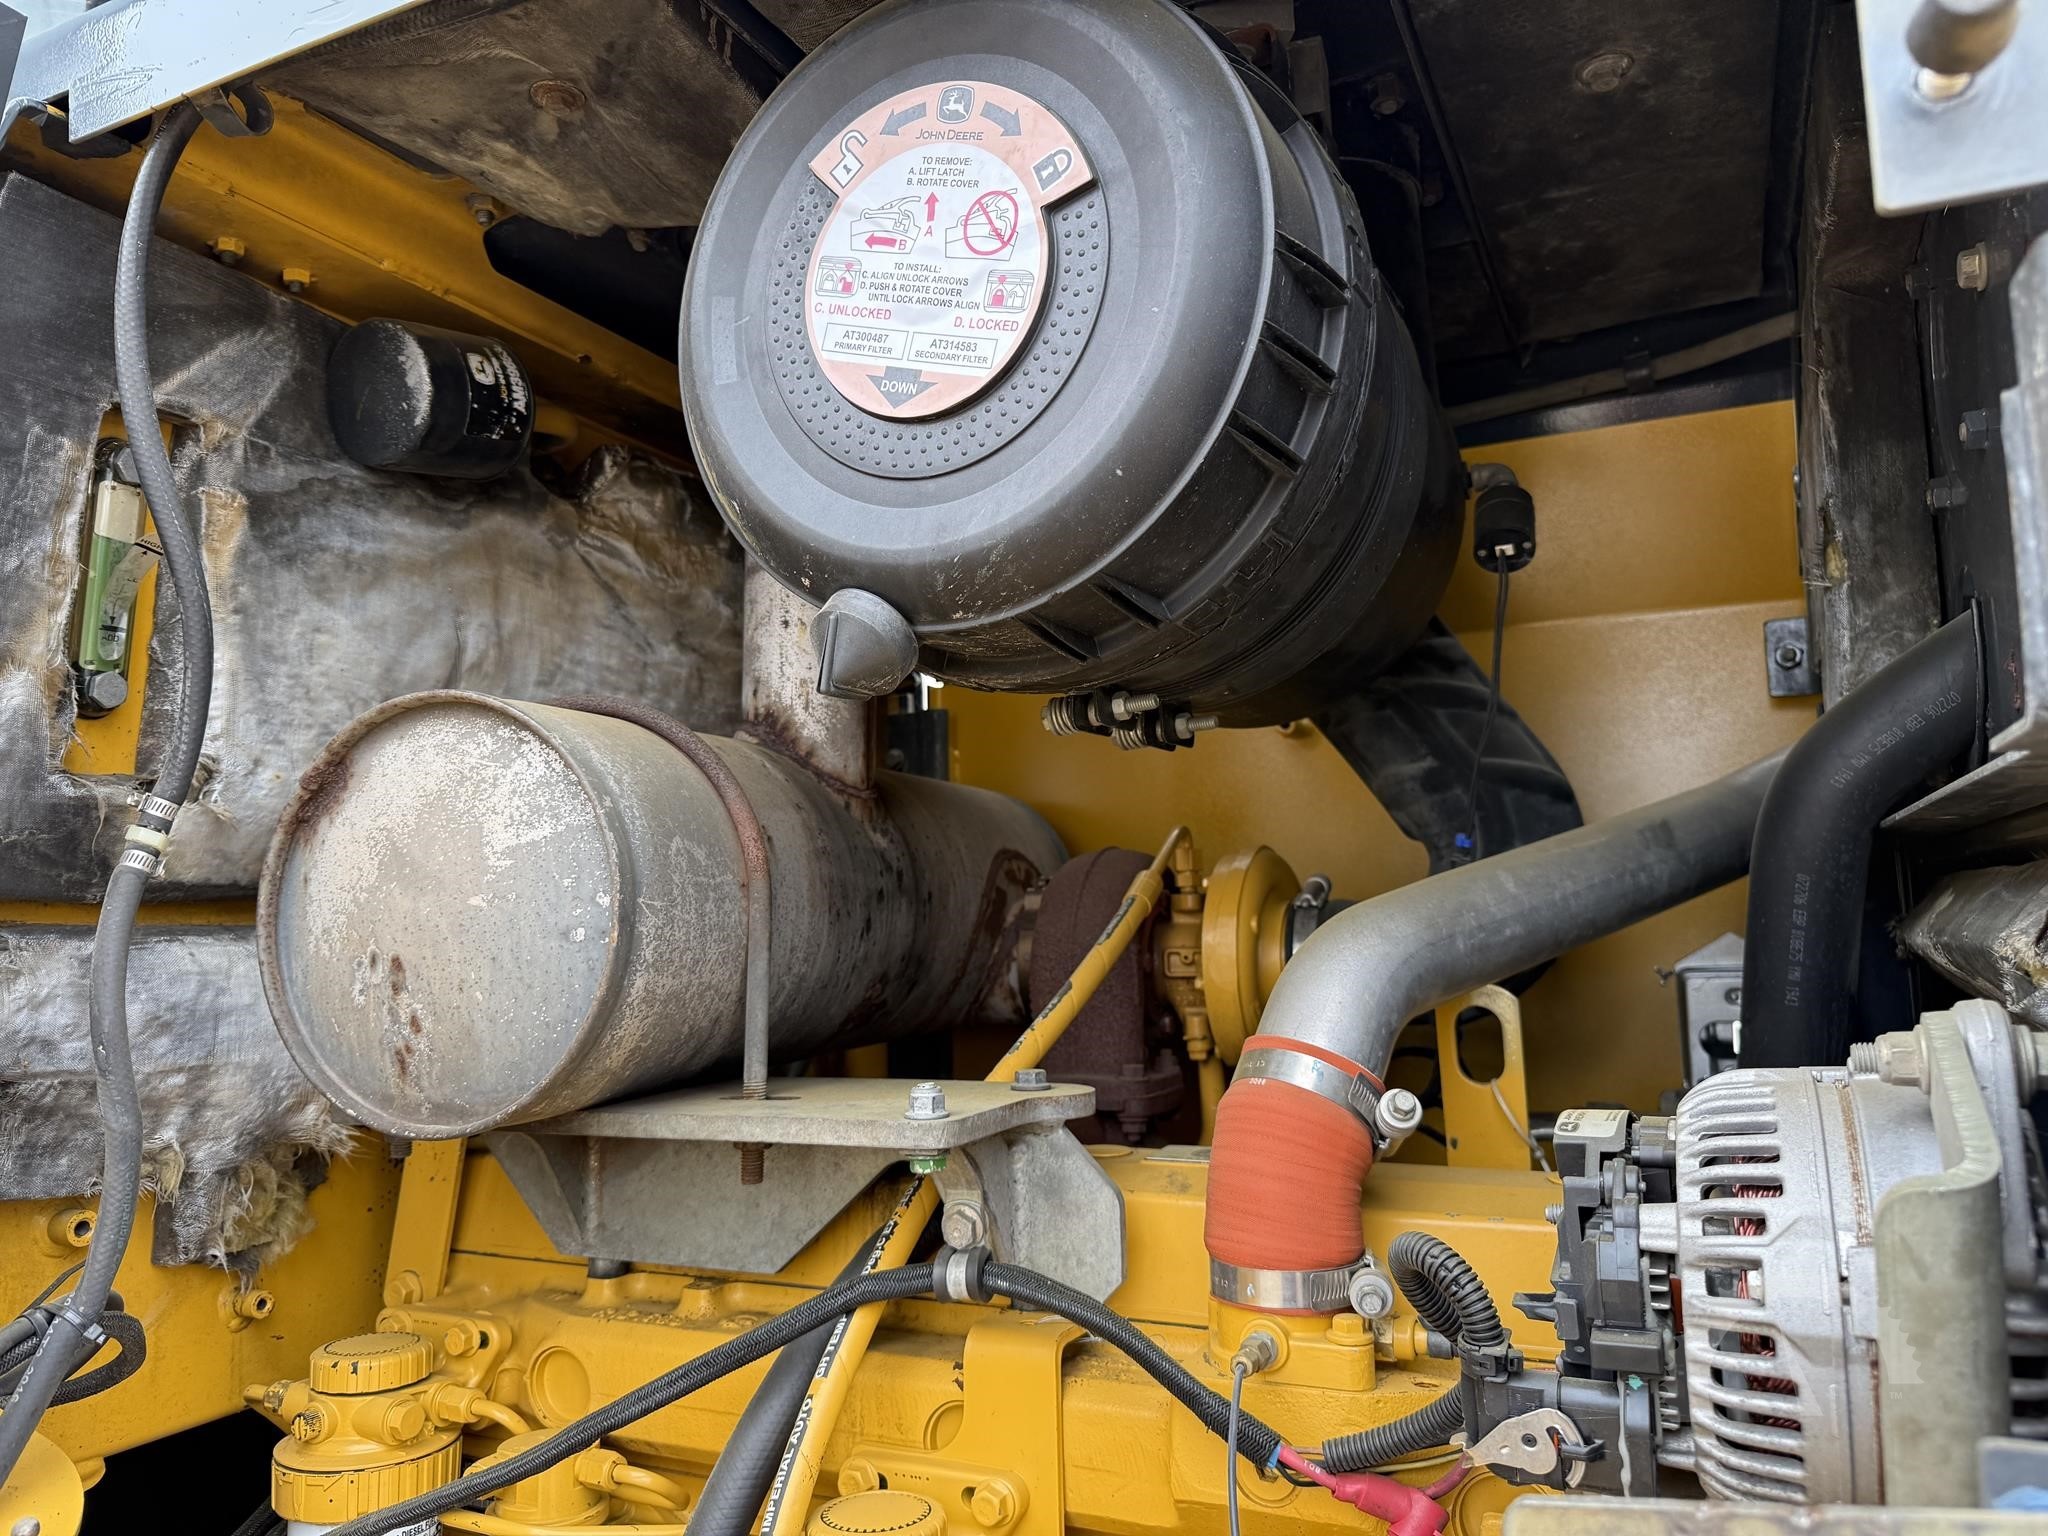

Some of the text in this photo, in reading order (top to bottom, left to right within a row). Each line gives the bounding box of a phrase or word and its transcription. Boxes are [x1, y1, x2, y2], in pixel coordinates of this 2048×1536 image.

[916, 129, 983, 141] JOHN DEERE
[922, 157, 973, 166] TO REMOVE:
[908, 167, 965, 177] A. LIFT LATCH
[906, 178, 980, 188] B. ROTATE COVER
[924, 225, 933, 237] A
[898, 239, 907, 251] B
[894, 262, 942, 274] TO INSTALL:
[862, 270, 969, 287] C. ALIGN UNLOCK ARROWS
[860, 281, 963, 298] D. PUSH & ROTATE COVER
[868, 293, 981, 311] UNTIL LOCK ARROWS ALIGN
[814, 302, 892, 321] C. UNLOCKED
[954, 316, 1019, 332] D. LOCKED
[842, 329, 889, 343] AT300487
[834, 341, 893, 355] PRIMARY FILTER
[929, 338, 978, 353] AT314583
[914, 350, 988, 365] SECONDARY FILTER
[880, 380, 918, 395] DOWN
[762, 1448, 795, 1533] IMPERIAL
[792, 1398, 812, 1445] AUTO
